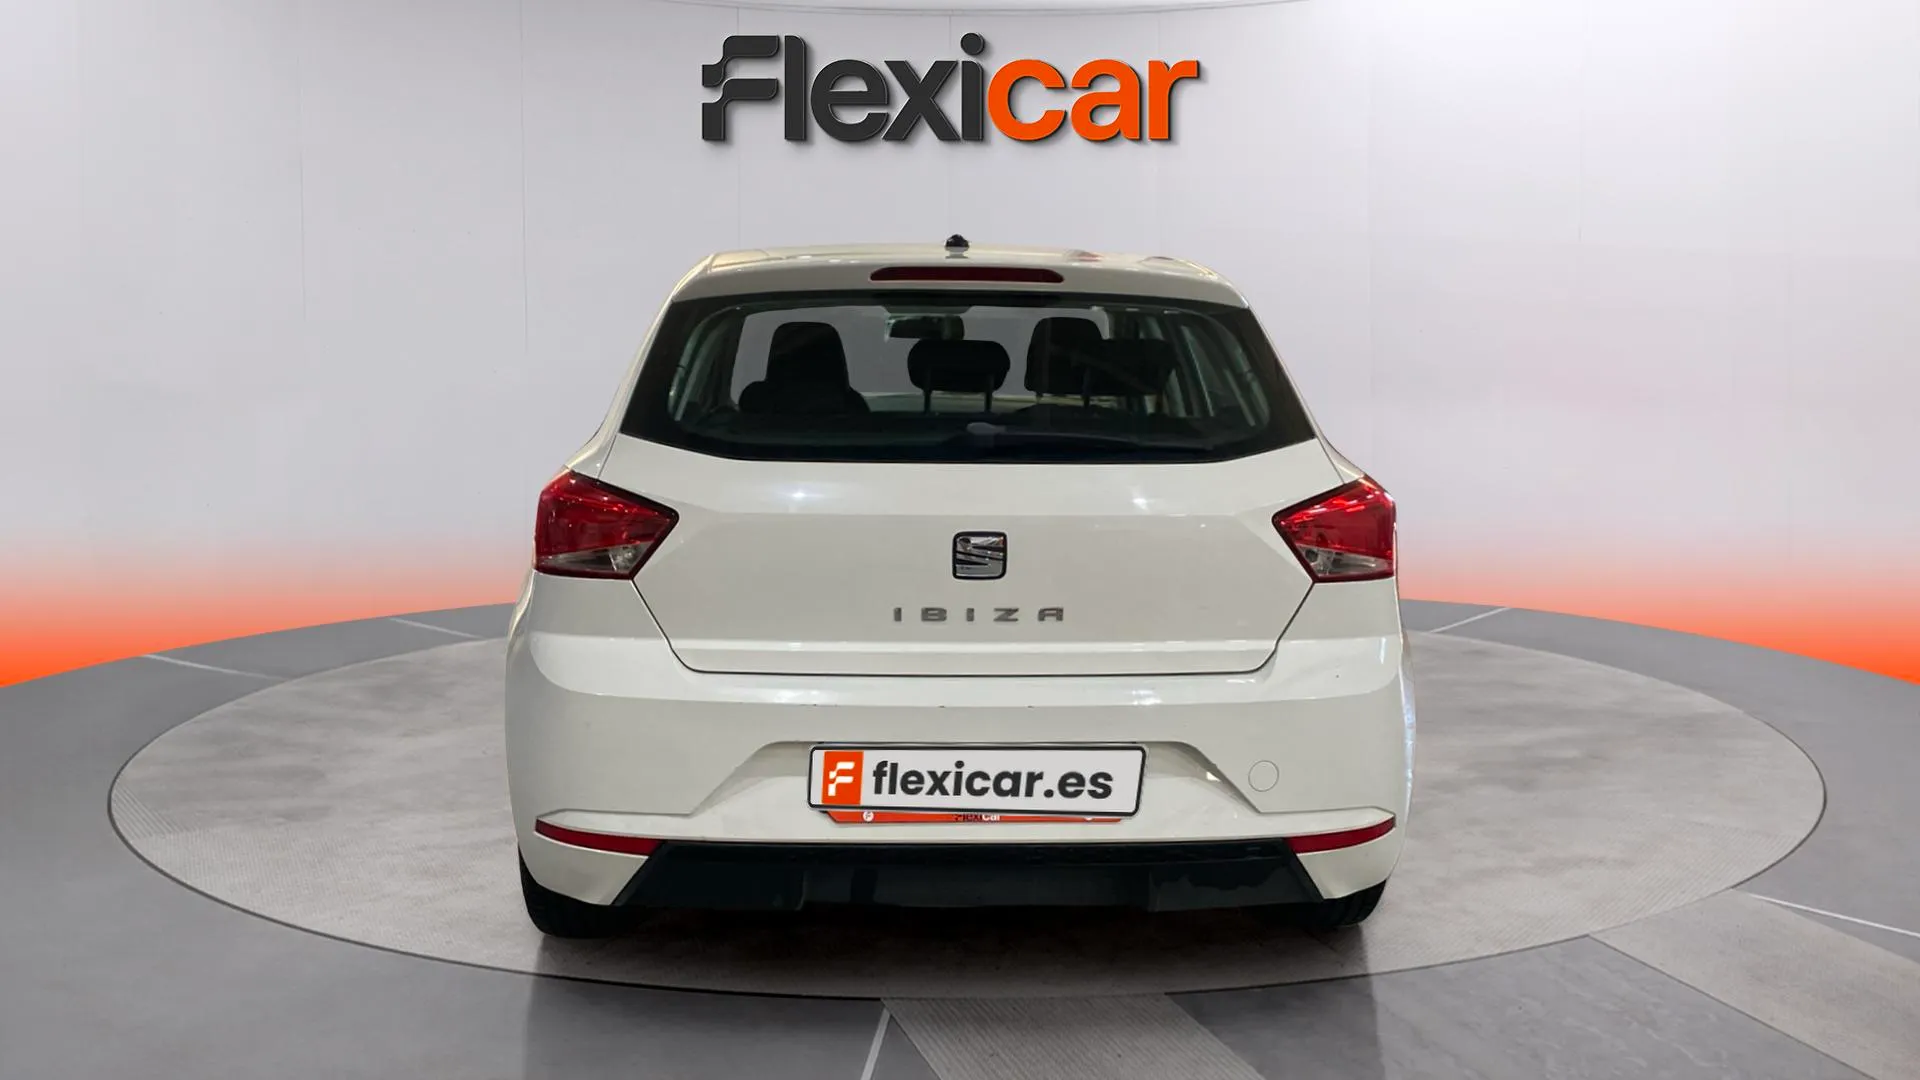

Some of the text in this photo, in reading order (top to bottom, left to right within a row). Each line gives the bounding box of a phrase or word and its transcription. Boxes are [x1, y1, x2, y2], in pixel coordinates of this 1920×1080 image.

[702, 32, 1200, 142] Flexicar
[893, 607, 1064, 622] IBIZA
[872, 760, 1113, 799] flexicar.es
